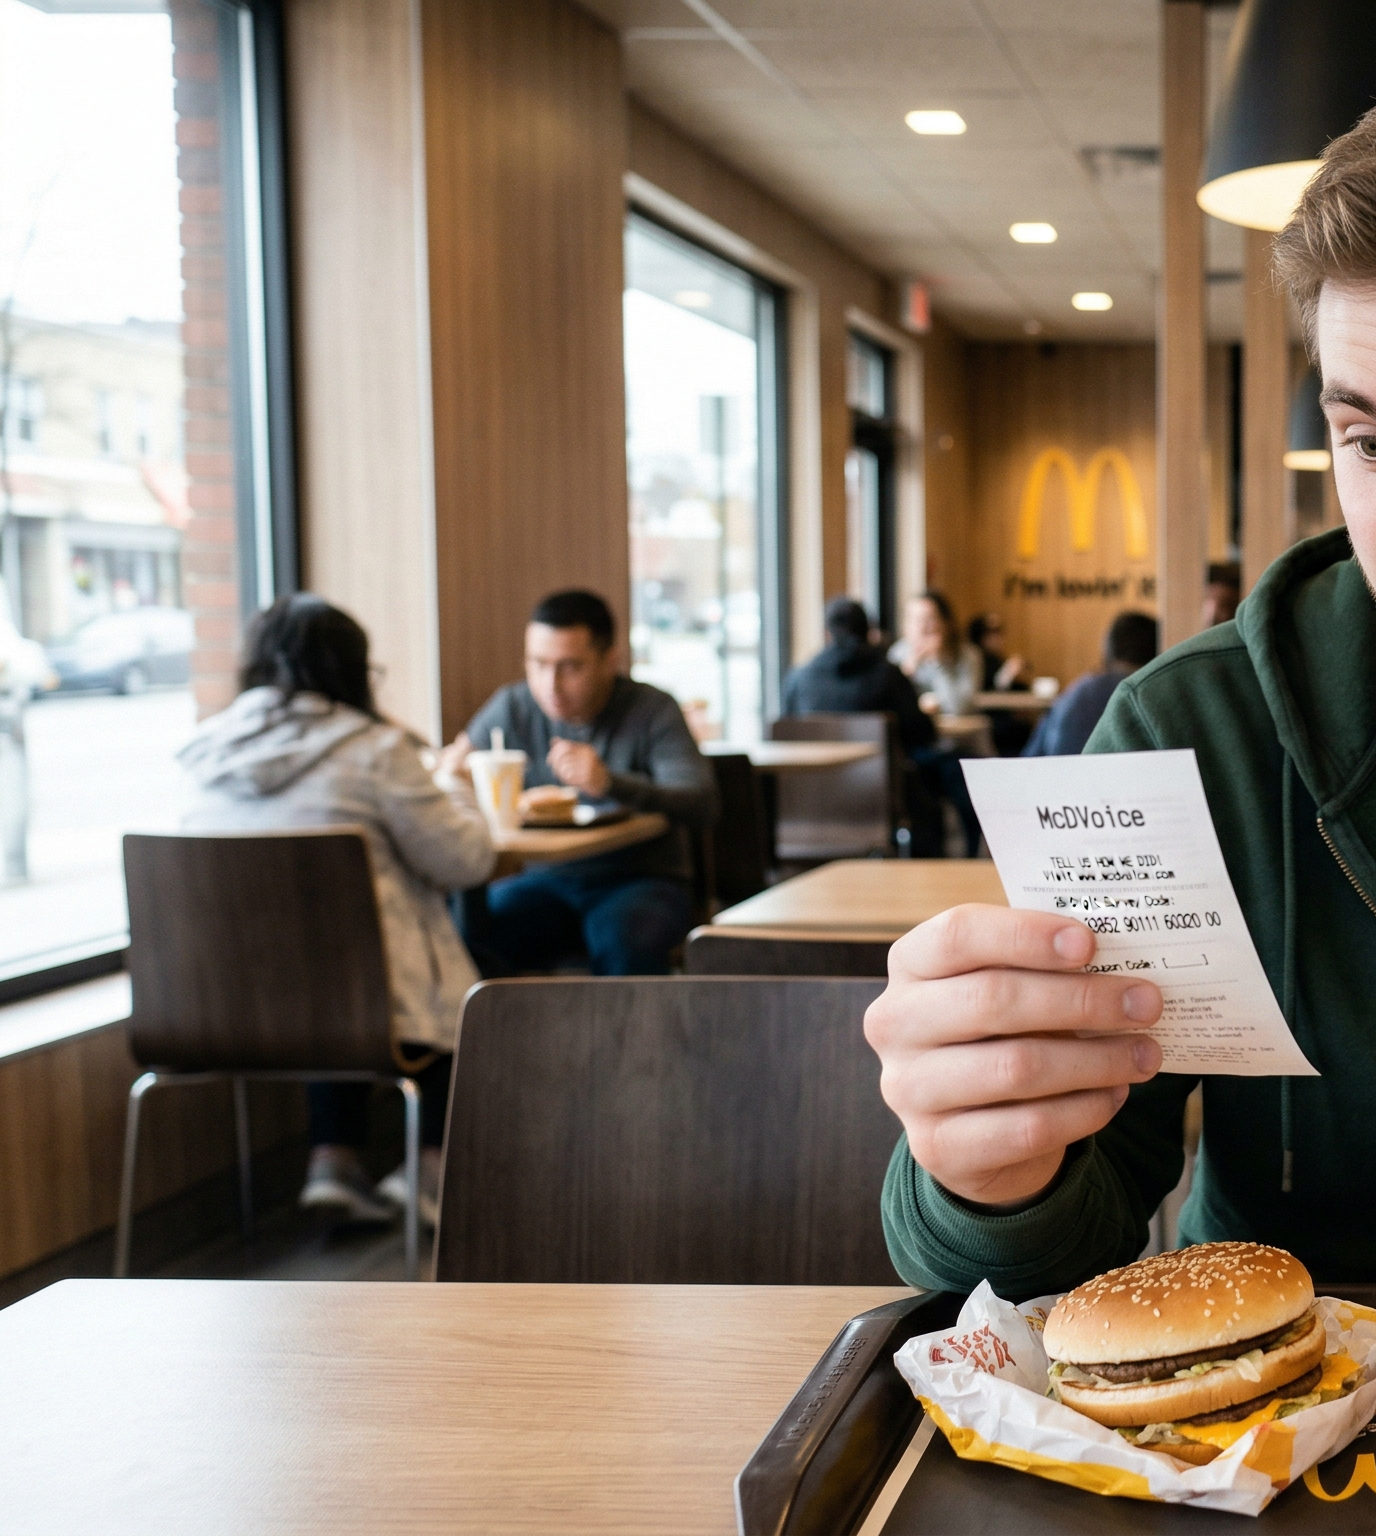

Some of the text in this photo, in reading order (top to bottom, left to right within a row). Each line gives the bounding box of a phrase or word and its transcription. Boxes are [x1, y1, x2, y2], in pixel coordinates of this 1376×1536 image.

[1037, 805, 1146, 830] McDVoice
[1050, 856, 1075, 869] TELL
[1079, 856, 1092, 869] US
[1096, 856, 1114, 868] HOW
[1123, 915, 1160, 932] 90111
[1204, 911, 1222, 927] 00
